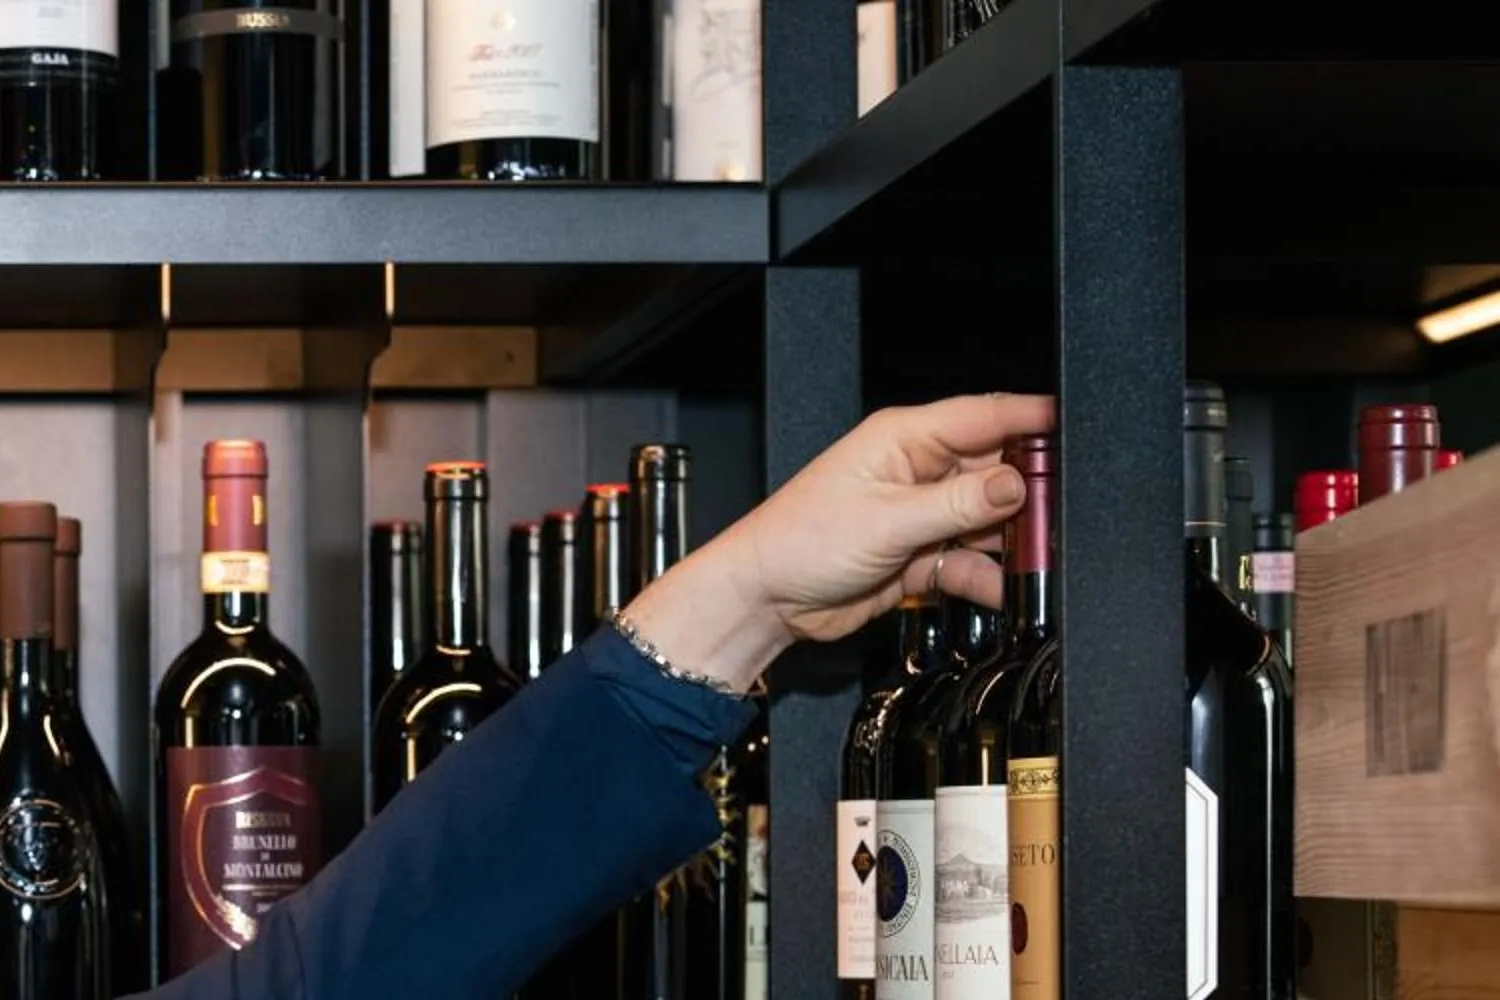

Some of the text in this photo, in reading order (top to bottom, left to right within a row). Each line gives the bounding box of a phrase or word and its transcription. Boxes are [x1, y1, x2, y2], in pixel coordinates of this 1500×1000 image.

[31, 53, 69, 65] GAJA
[232, 834, 297, 850] BRUNELLO
[223, 863, 304, 878] MONTALCINO
